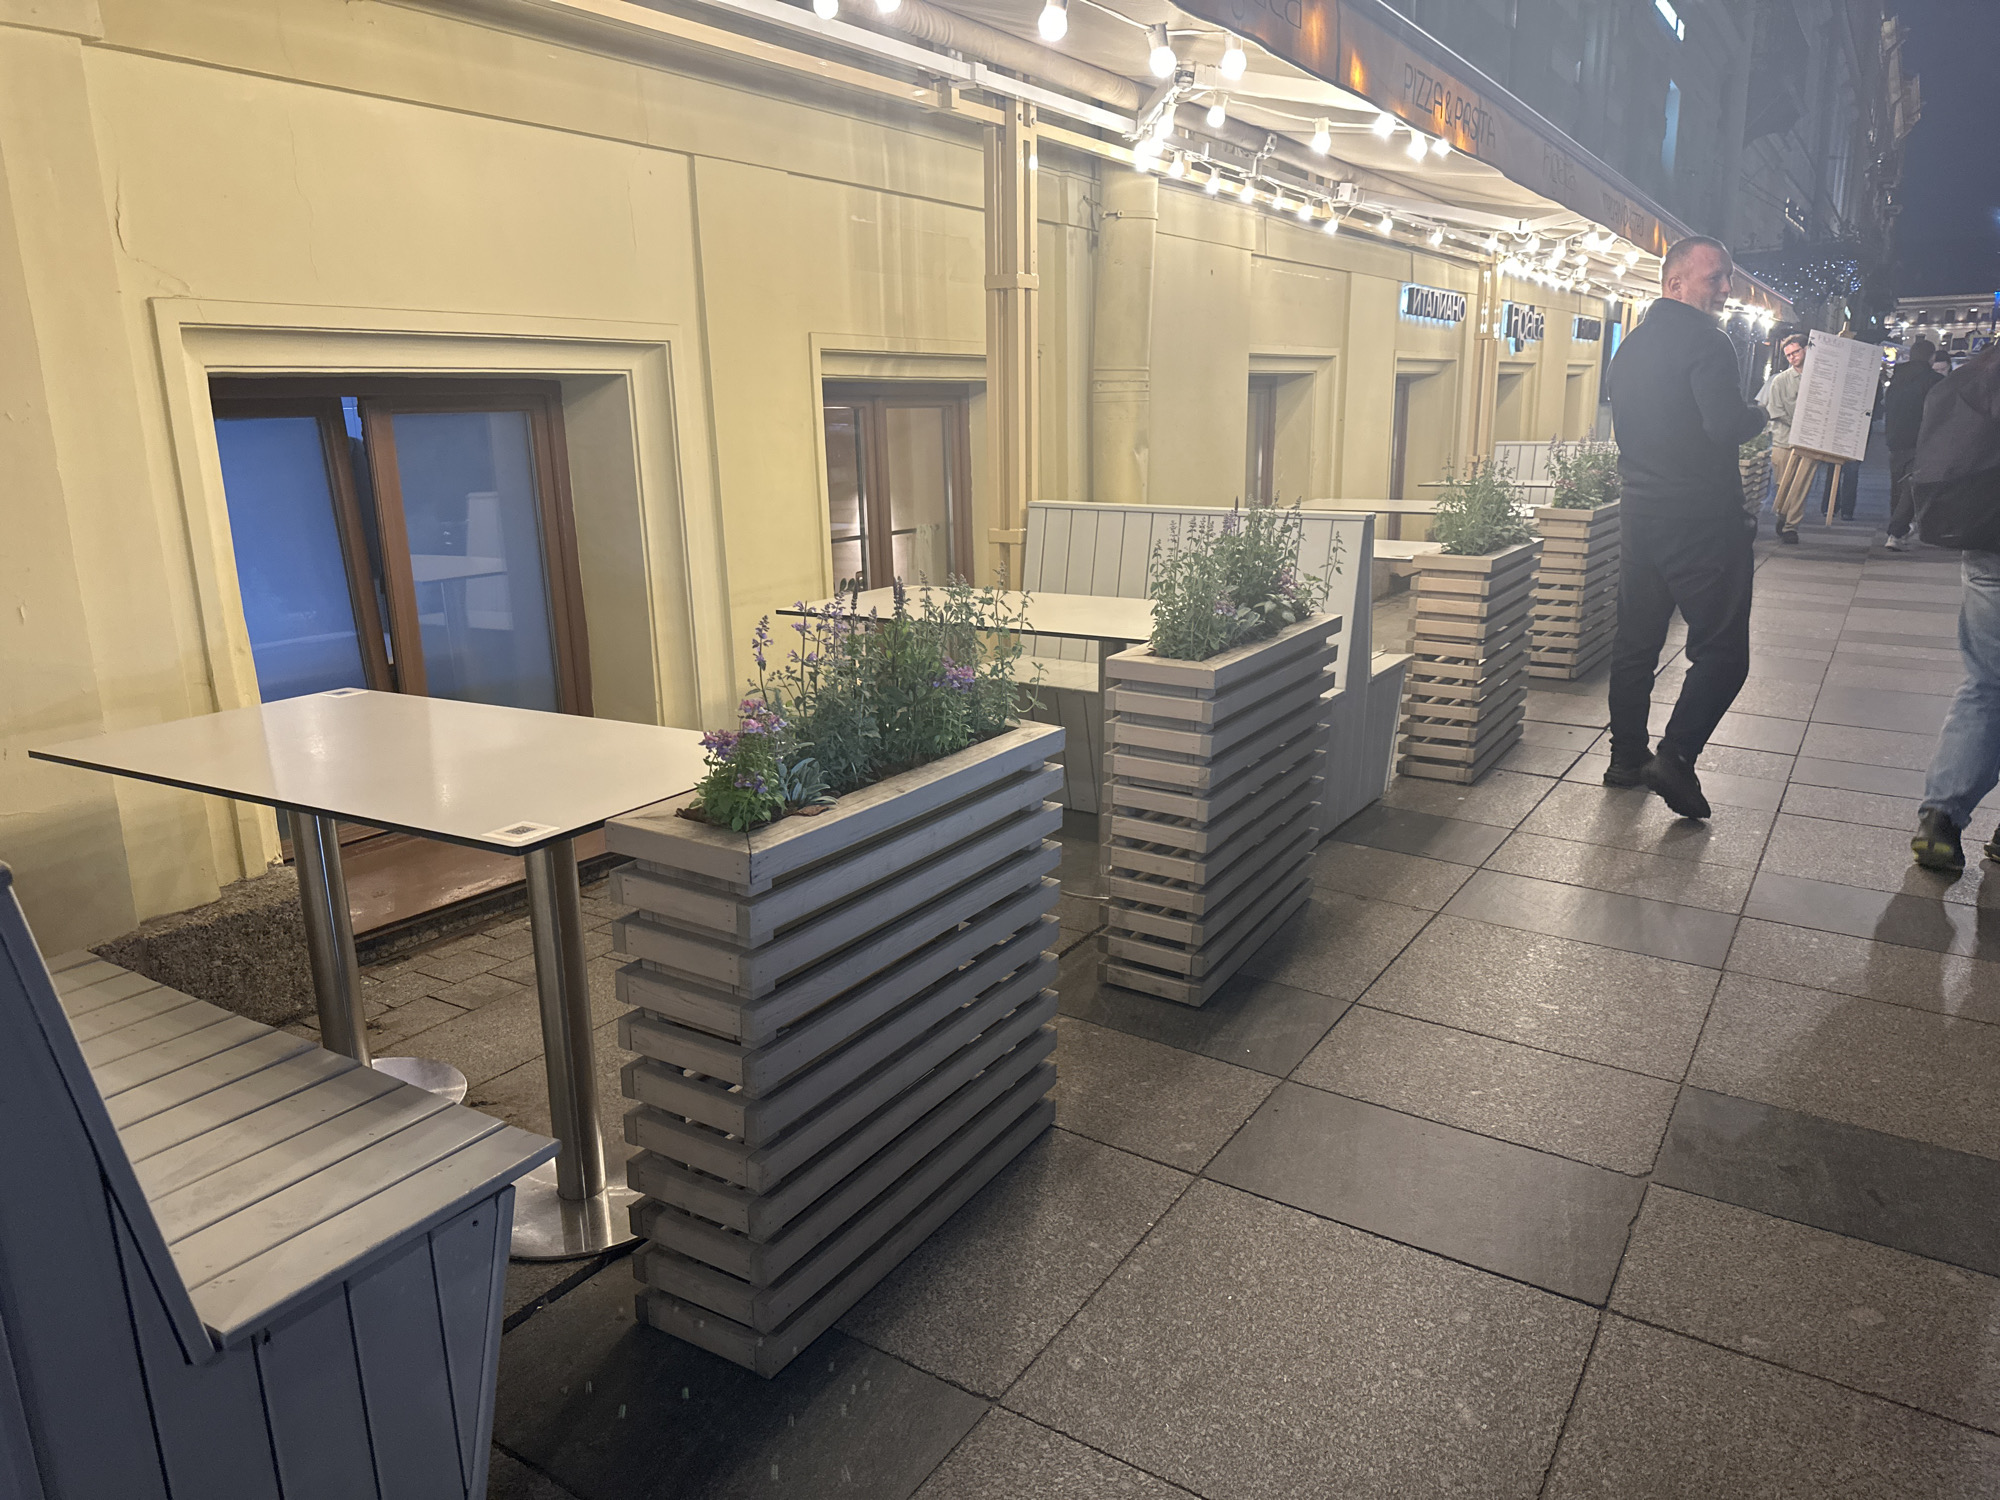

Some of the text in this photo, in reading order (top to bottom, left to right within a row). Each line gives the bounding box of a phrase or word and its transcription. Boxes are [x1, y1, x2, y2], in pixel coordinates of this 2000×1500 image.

[1403, 62, 1496, 149] PIZZA & PASTA
[1409, 286, 1467, 322] ИТАЛИАНО
